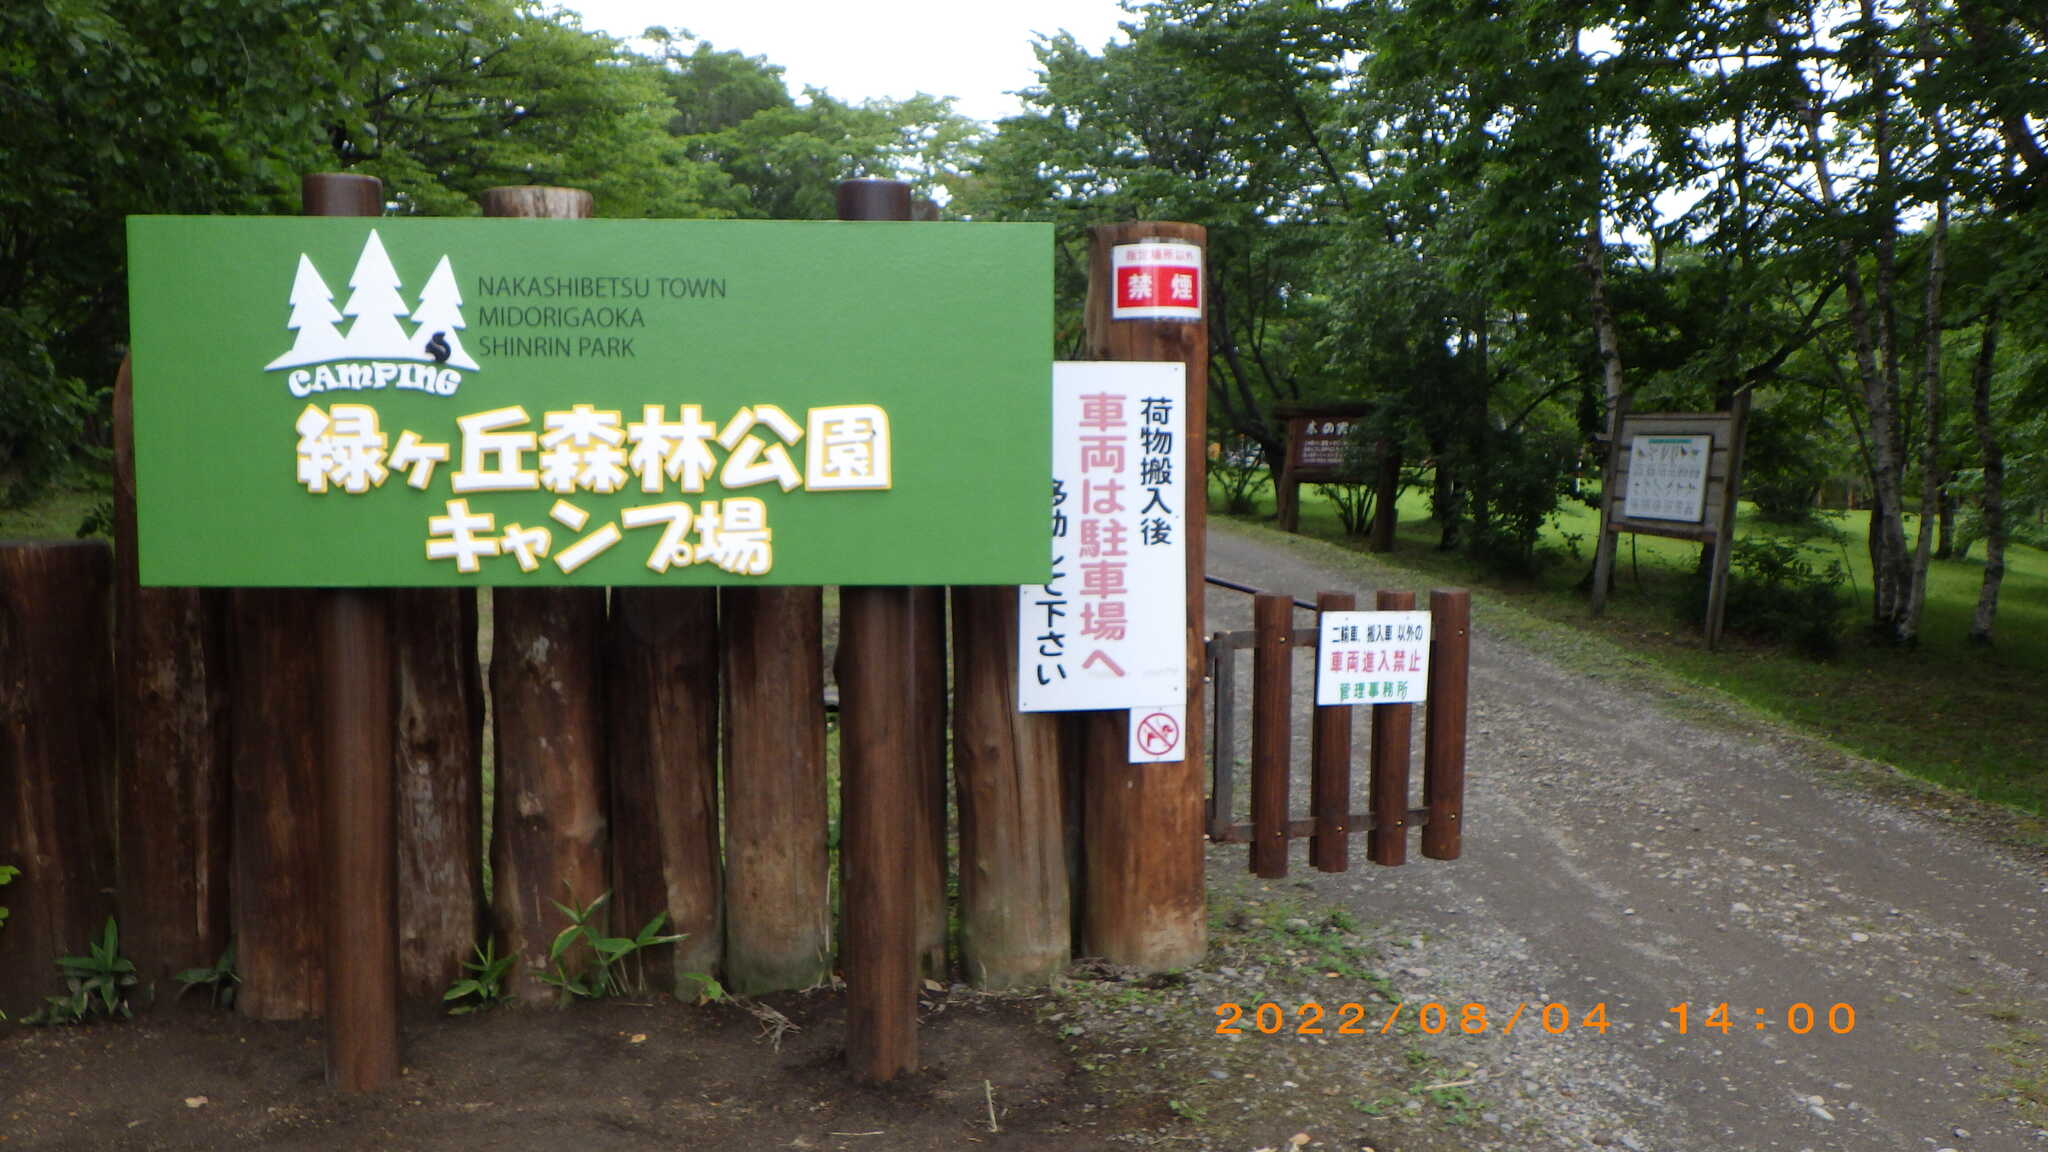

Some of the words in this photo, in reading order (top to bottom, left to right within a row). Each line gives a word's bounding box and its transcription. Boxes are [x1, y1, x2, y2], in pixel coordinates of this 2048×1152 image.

[477, 276, 650, 298] NAKASHIBETSU
[657, 277, 727, 299] TOWN
[1128, 273, 1193, 300] 禁煙
[478, 306, 645, 328] MIDORIGAOKA
[478, 336, 571, 357] SHINRIN
[578, 337, 636, 358] PARK
[296, 403, 892, 493] 緑ヶ丘森林公園
[1140, 397, 1173, 546] 荷物搬入後
[426, 498, 773, 576] キャンプ場
[1079, 392, 1128, 678] 車両は駐車場へ
[1330, 650, 1421, 673] 車両進入禁止
[1339, 681, 1408, 701] 管理事務所
